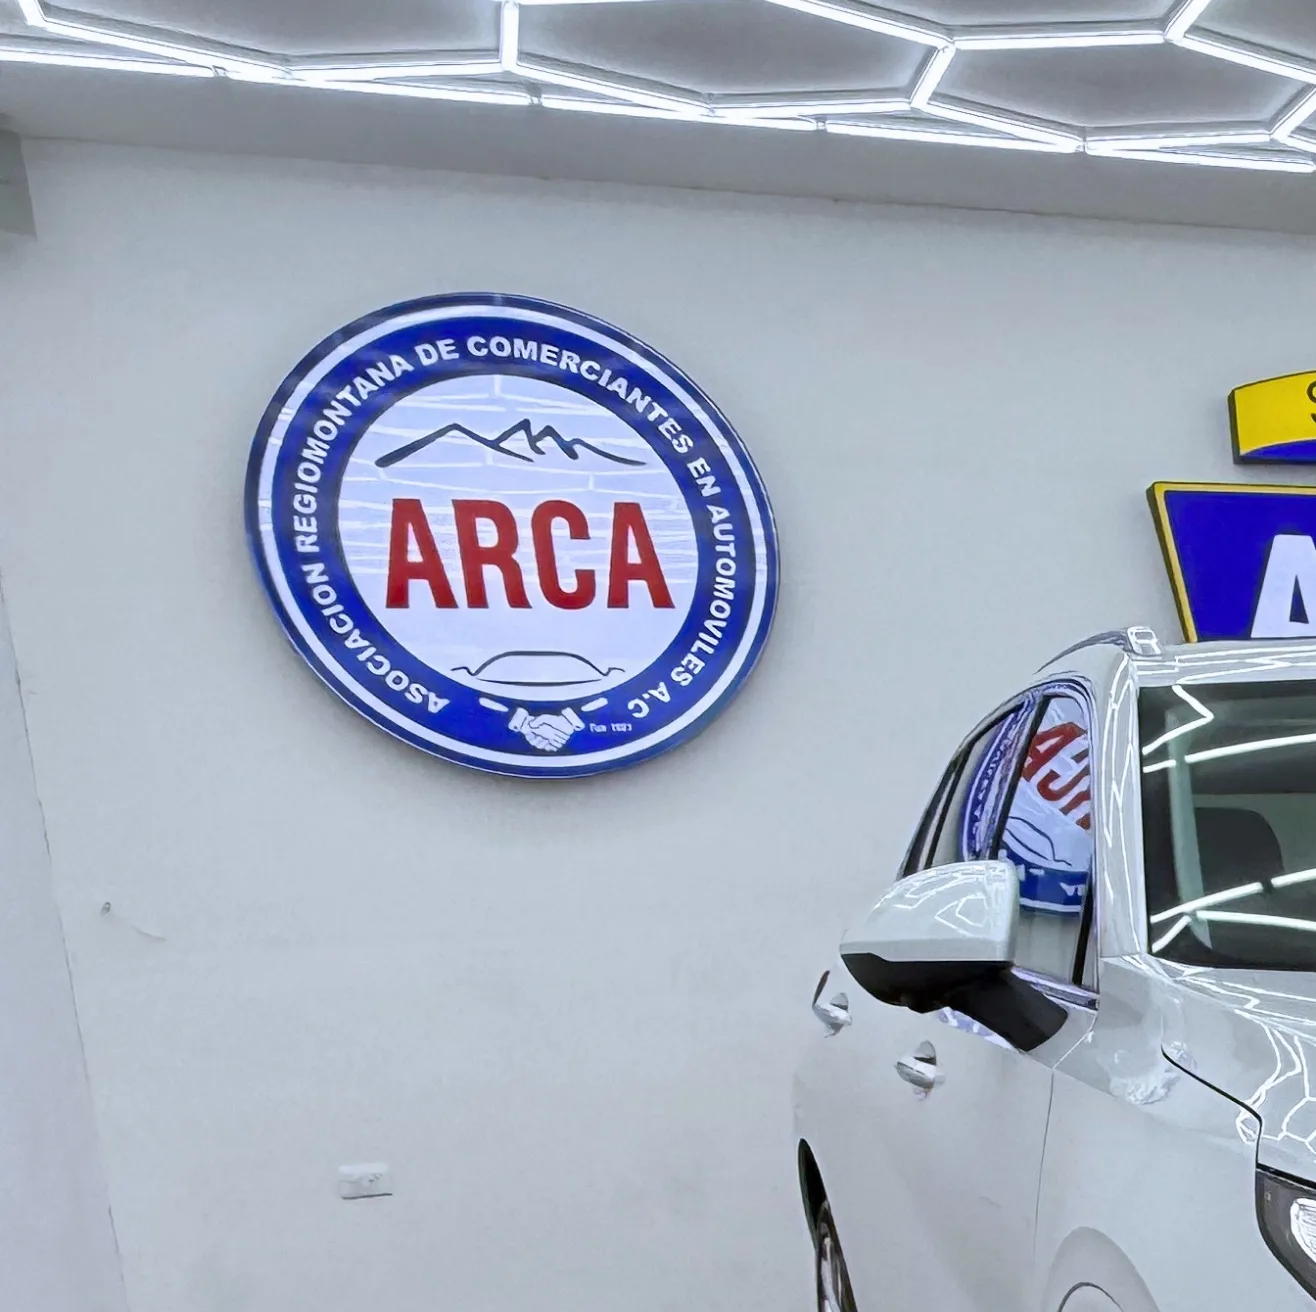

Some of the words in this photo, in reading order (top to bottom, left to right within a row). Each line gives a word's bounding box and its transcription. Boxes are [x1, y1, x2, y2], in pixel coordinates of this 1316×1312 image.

[414, 339, 460, 366] DE
[466, 335, 693, 454] COMERCIANTES
[294, 353, 414, 553] REGIOMONTANA
[687, 456, 721, 497] EN
[385, 498, 675, 610] ARCA
[670, 504, 737, 686] AUTOMOVILES
[302, 564, 451, 713] ASOCIACION
